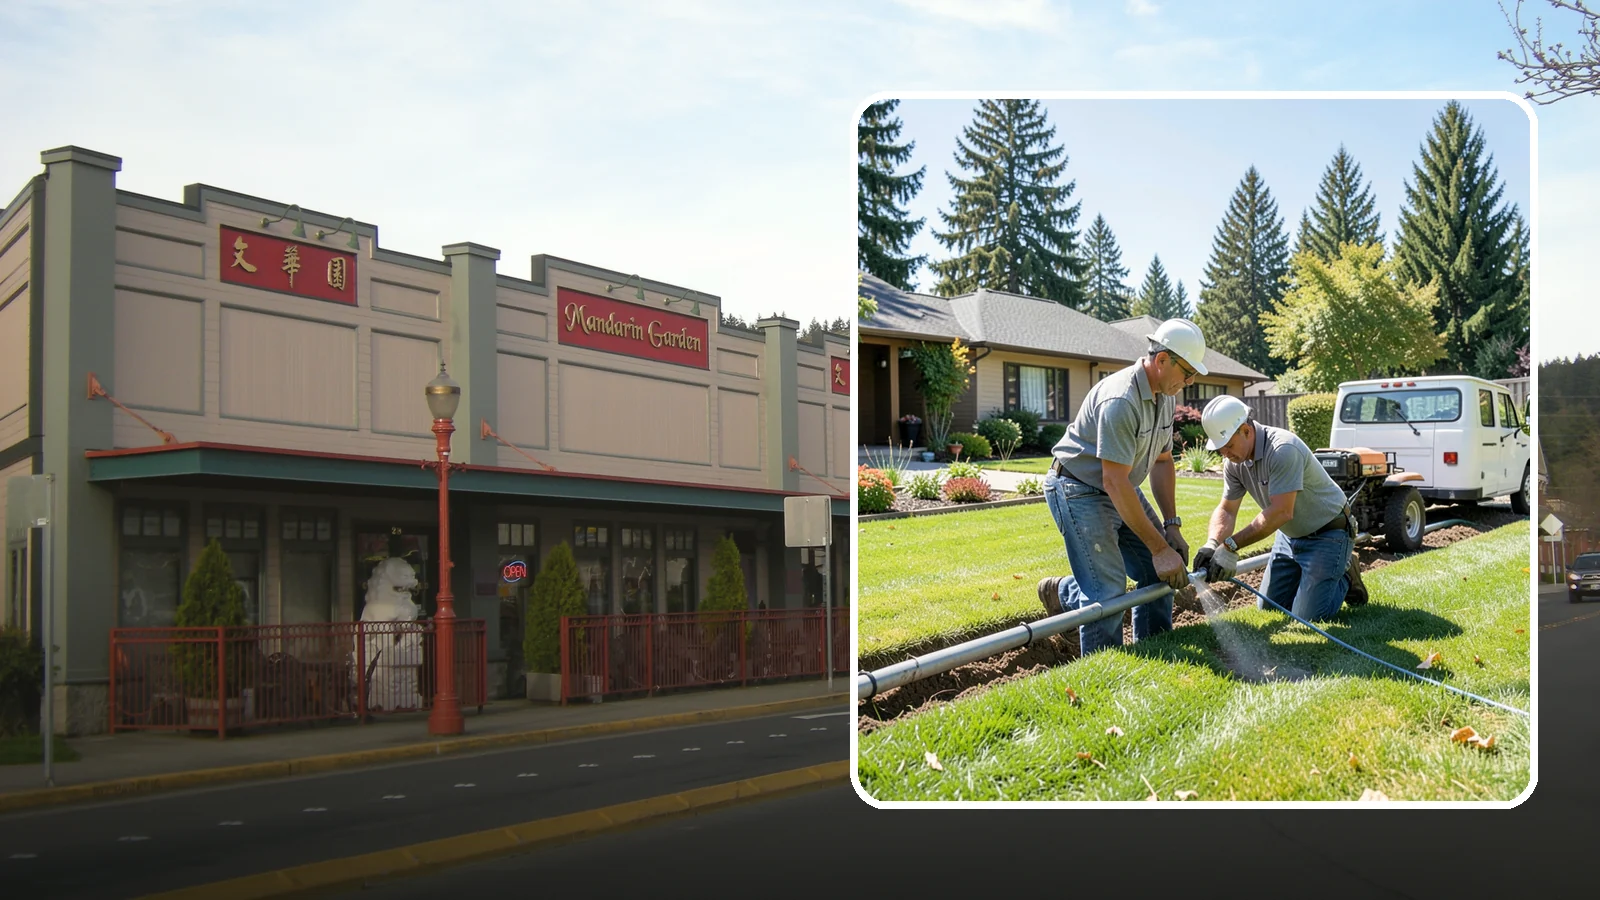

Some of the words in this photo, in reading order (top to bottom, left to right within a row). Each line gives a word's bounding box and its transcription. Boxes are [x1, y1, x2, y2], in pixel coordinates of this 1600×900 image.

[564, 302, 644, 341] Mandarin
[648, 320, 701, 352] Garden
[503, 565, 527, 578] OPEN
